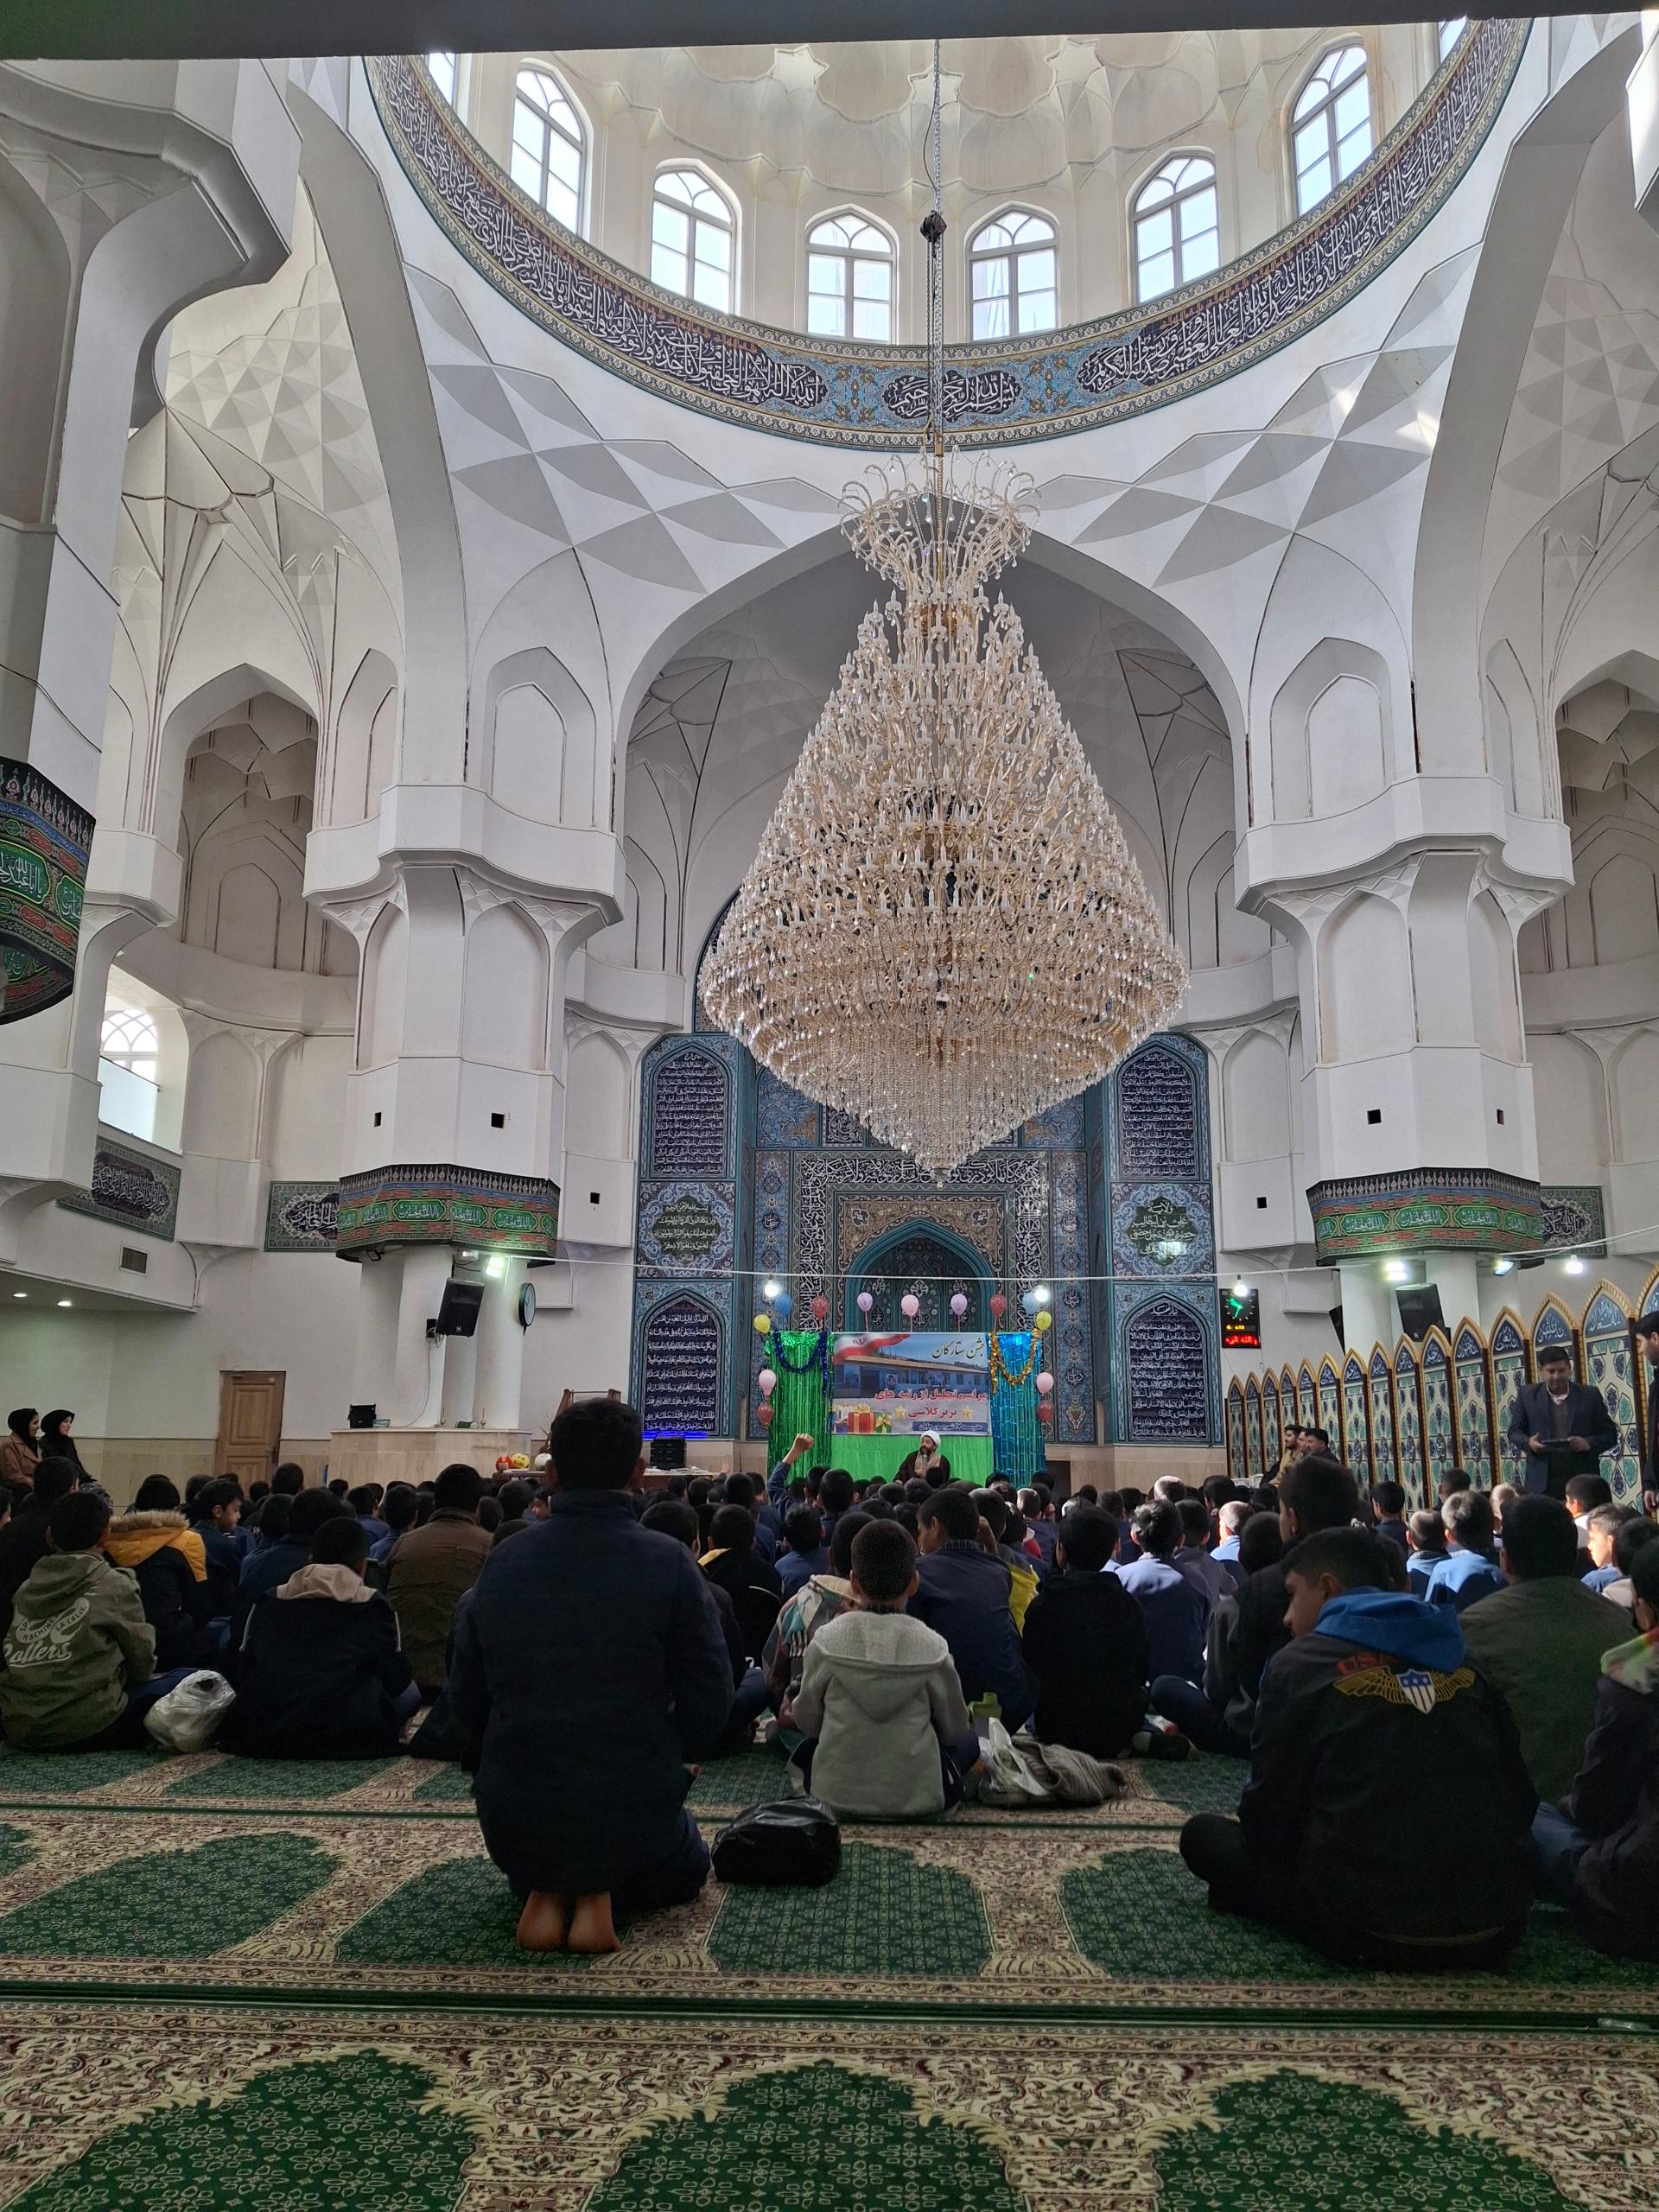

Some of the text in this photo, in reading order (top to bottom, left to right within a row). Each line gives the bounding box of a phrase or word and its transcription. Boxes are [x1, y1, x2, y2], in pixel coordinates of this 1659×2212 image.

[966, 1337, 984, 1359] جشن
[874, 1388, 988, 1402] مراسم تجلیل از رتبه های
[908, 1406, 939, 1418] کلاسی
[55, 1621, 66, 1631] LA
